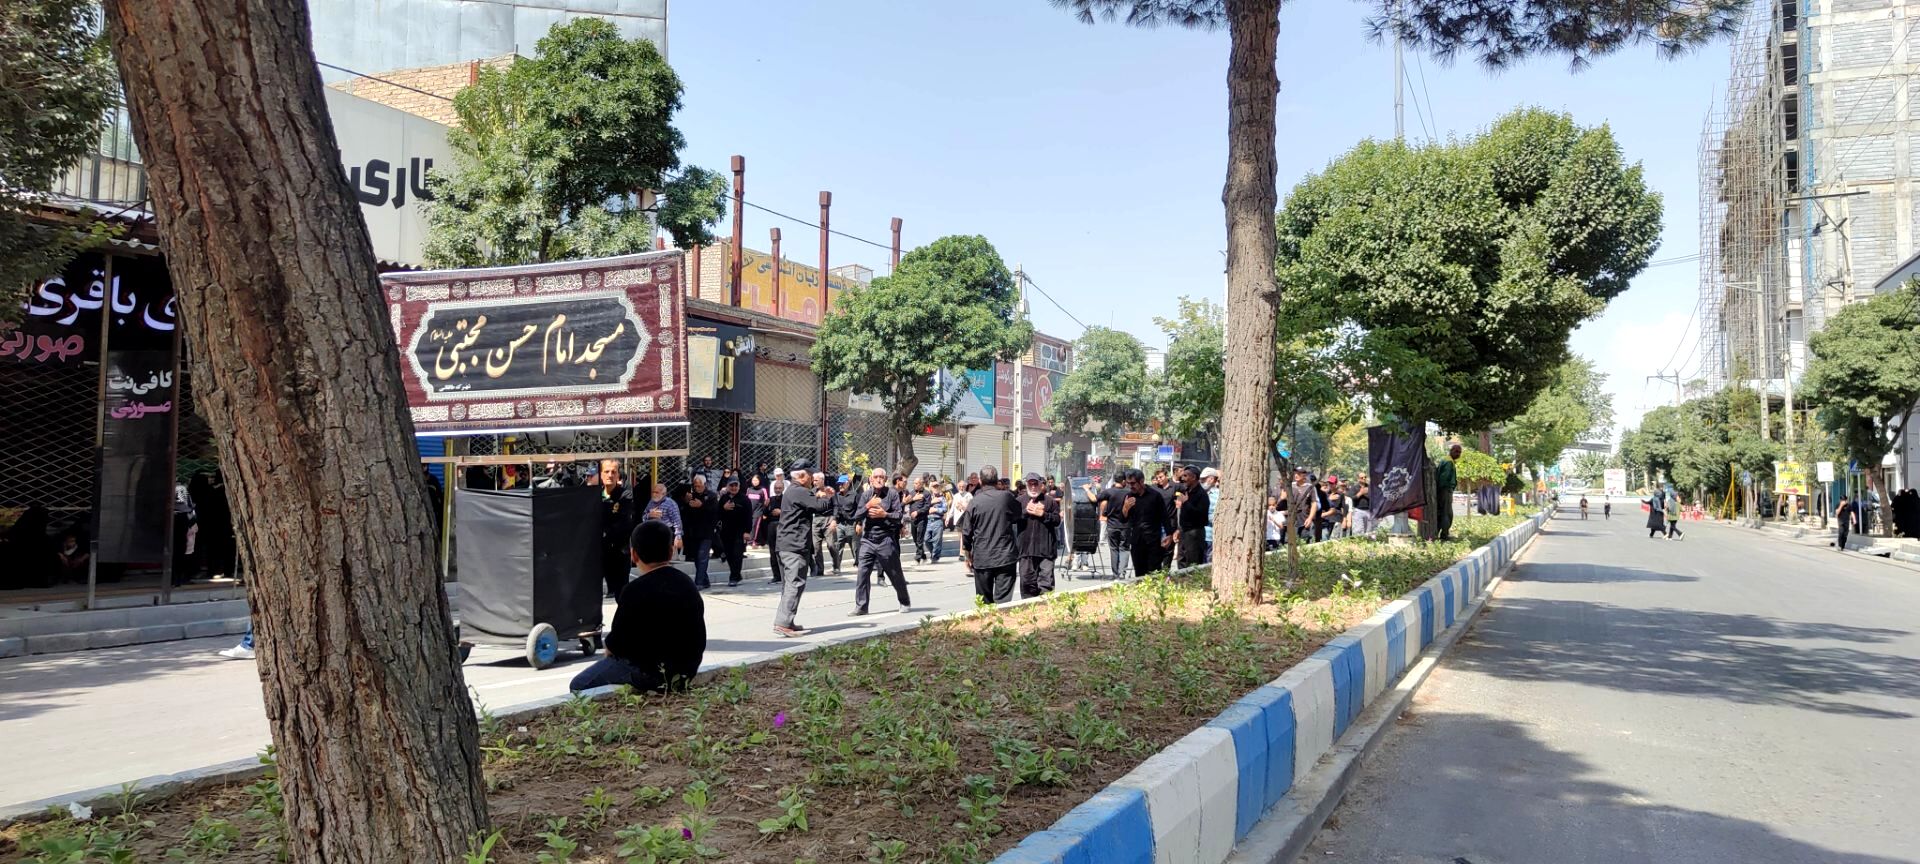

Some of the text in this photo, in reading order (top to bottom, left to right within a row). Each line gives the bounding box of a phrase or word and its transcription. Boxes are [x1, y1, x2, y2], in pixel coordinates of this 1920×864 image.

[25, 268, 137, 326] باقری
[435, 314, 488, 381] مجتبی
[486, 324, 538, 379] حسن
[543, 313, 575, 375] امام
[574, 322, 625, 380] مسجد
[110, 399, 173, 420] صورتی
